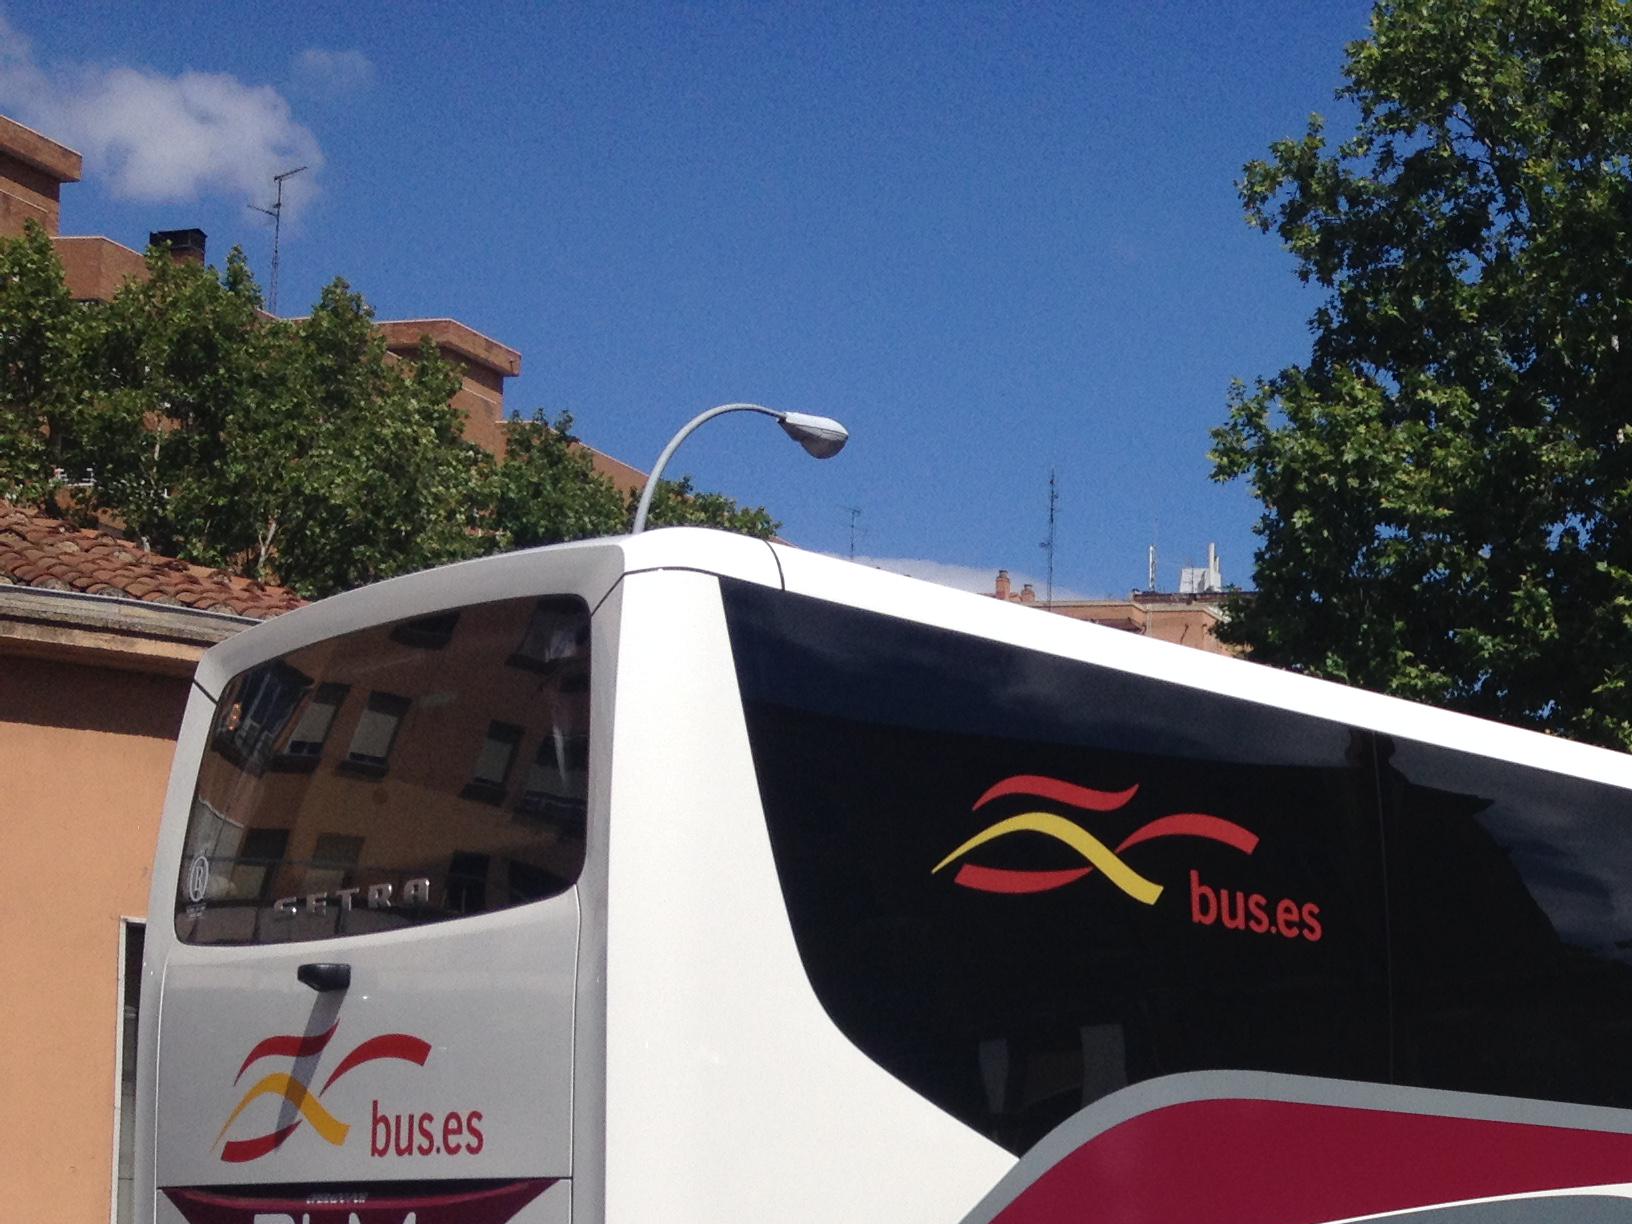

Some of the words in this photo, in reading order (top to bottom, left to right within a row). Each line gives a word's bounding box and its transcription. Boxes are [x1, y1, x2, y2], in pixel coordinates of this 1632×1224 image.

[273, 877, 430, 916] SETRA
[1190, 869, 1322, 942] bus.es
[371, 1099, 484, 1157] bus.es
